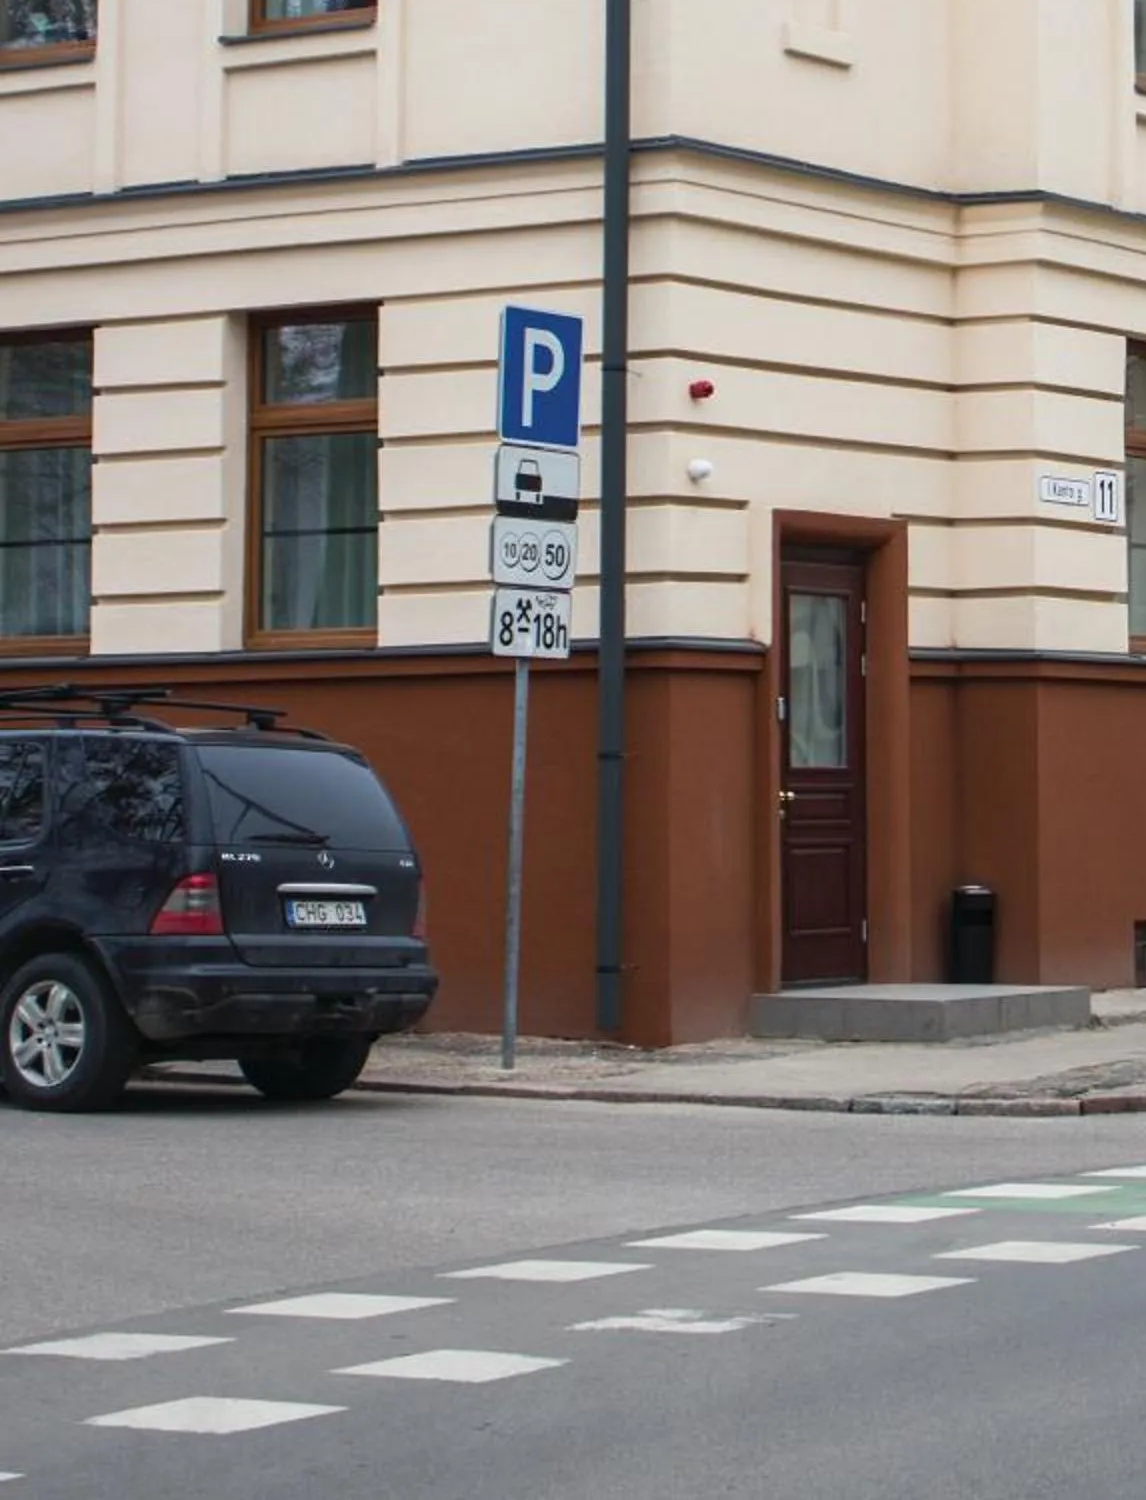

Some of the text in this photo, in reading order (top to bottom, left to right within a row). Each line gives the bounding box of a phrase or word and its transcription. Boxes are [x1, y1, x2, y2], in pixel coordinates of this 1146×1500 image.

[521, 326, 565, 428] P
[1099, 479, 1114, 514] 11
[504, 541, 565, 567] 10 20 50
[295, 902, 363, 922] CHG 034
